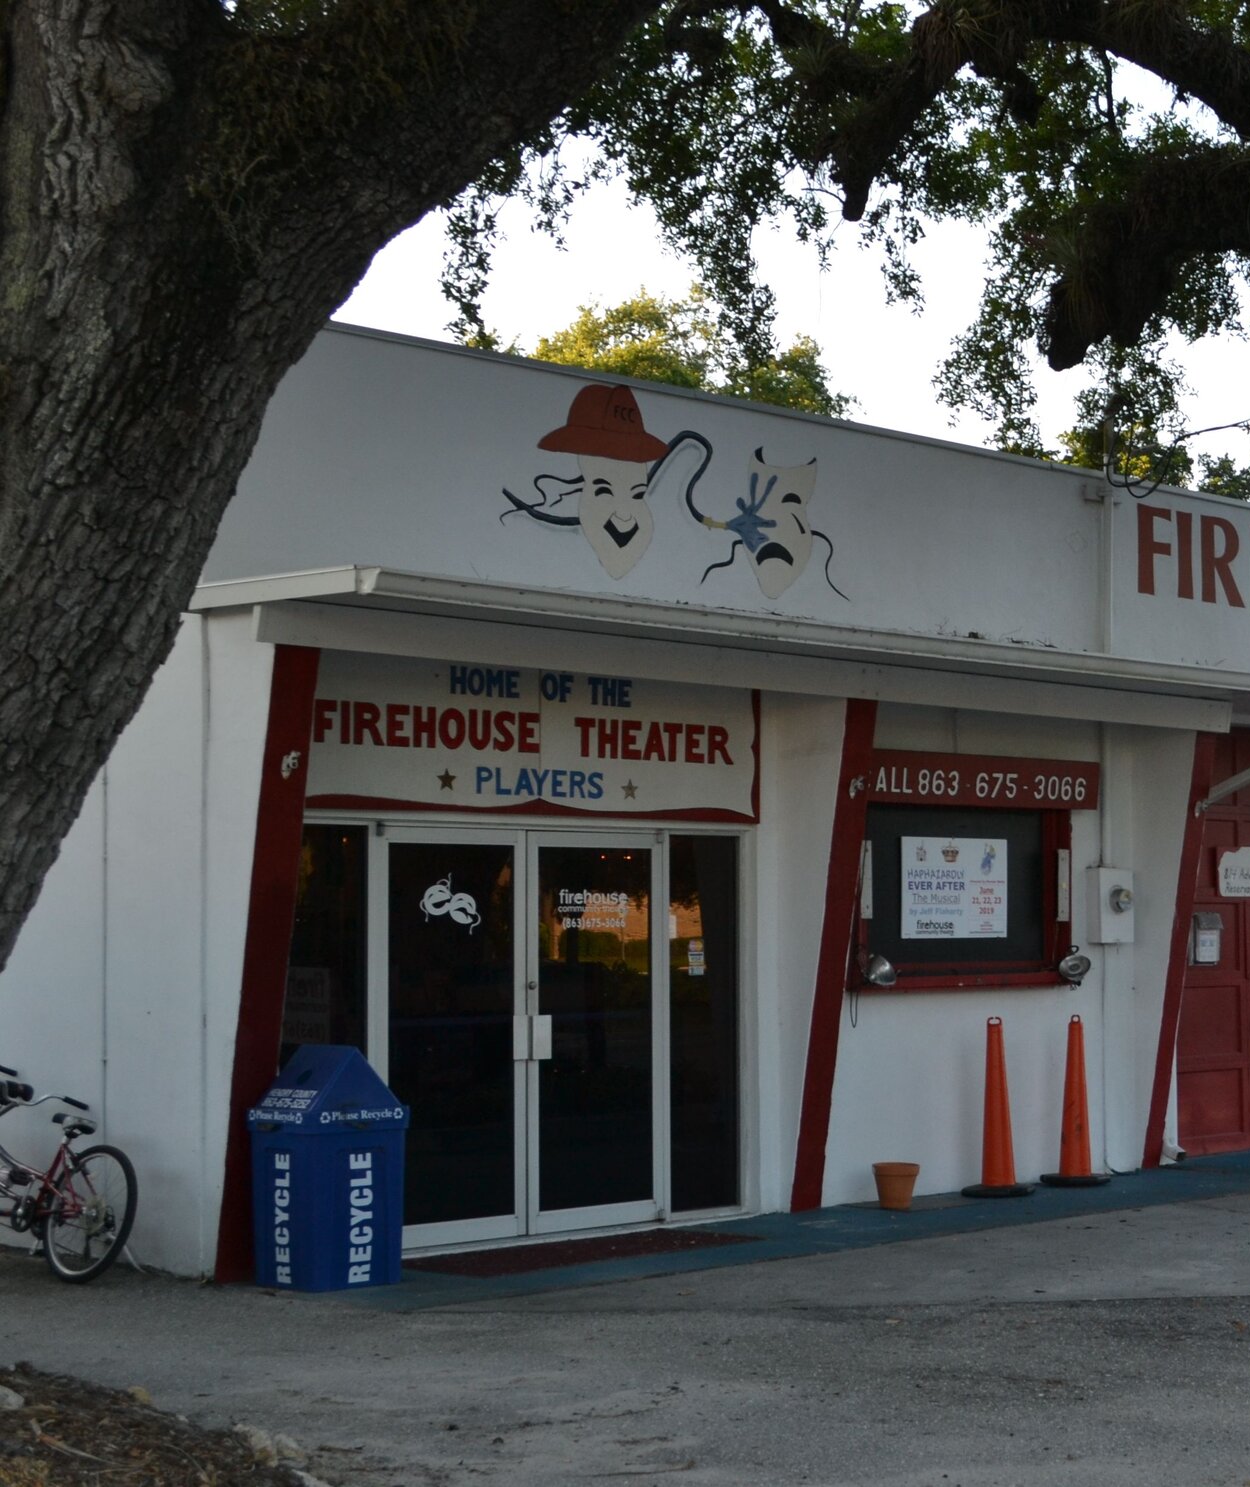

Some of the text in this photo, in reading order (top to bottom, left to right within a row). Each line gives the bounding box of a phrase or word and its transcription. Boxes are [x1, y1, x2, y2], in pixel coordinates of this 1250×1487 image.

[450, 665, 632, 708] HOME OF THE
[313, 699, 734, 765] FIREHOUSE THEATER
[475, 766, 604, 799] PLAYERS
[868, 766, 913, 794] ALL
[559, 889, 629, 905] firehouse
[908, 881, 933, 891] EVER
[936, 881, 965, 891] AFTER
[912, 893, 961, 903] The Musical
[562, 917, 626, 931] (863)675-3066
[916, 920, 954, 930] firehouse
[331, 1108, 393, 1121] Please Recycle
[275, 1153, 292, 1284] RECYCLE
[347, 1152, 374, 1284] RECYCLE
